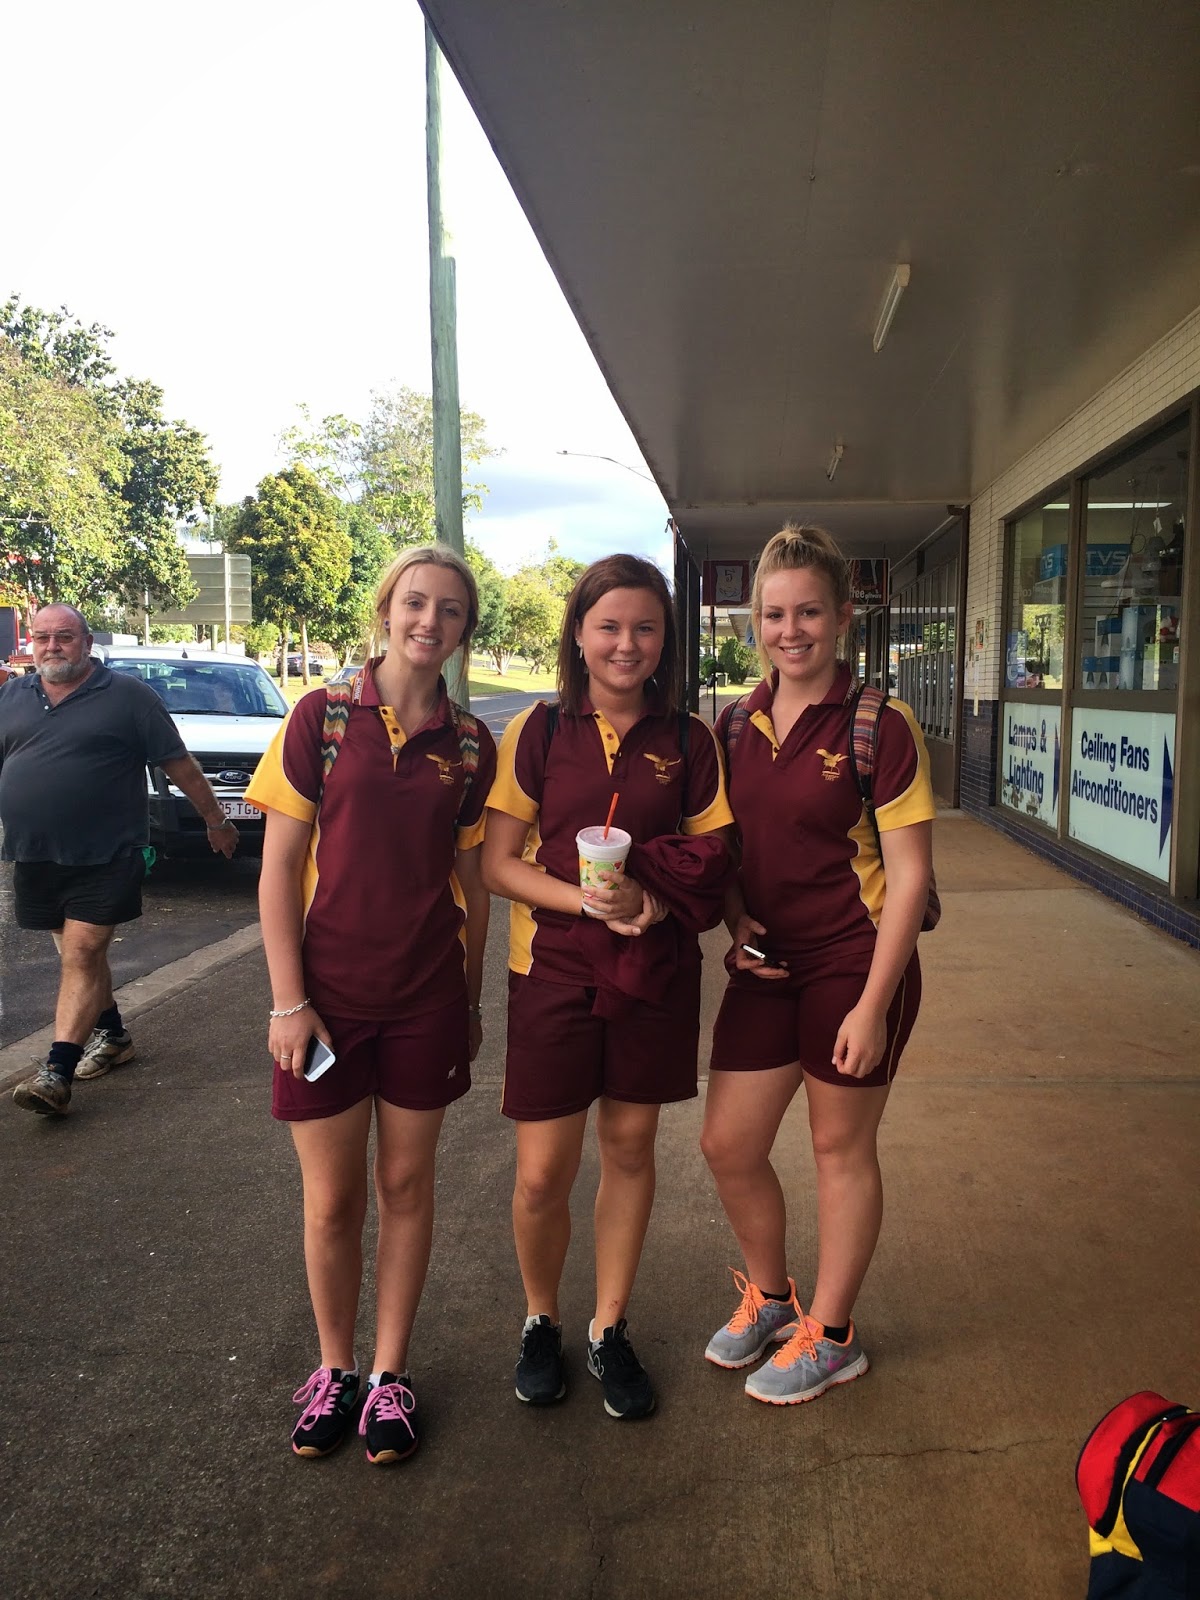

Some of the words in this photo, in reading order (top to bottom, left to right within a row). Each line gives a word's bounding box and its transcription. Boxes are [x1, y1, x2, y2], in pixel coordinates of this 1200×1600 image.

[1008, 716, 1037, 755] Lamps
[1040, 719, 1047, 753] &
[1081, 731, 1117, 772] Ceiling
[1120, 736, 1150, 771] Fans
[225, 772, 242, 780] Ford
[1008, 755, 1044, 804] Lighting
[1071, 769, 1158, 824] Airconditioners
